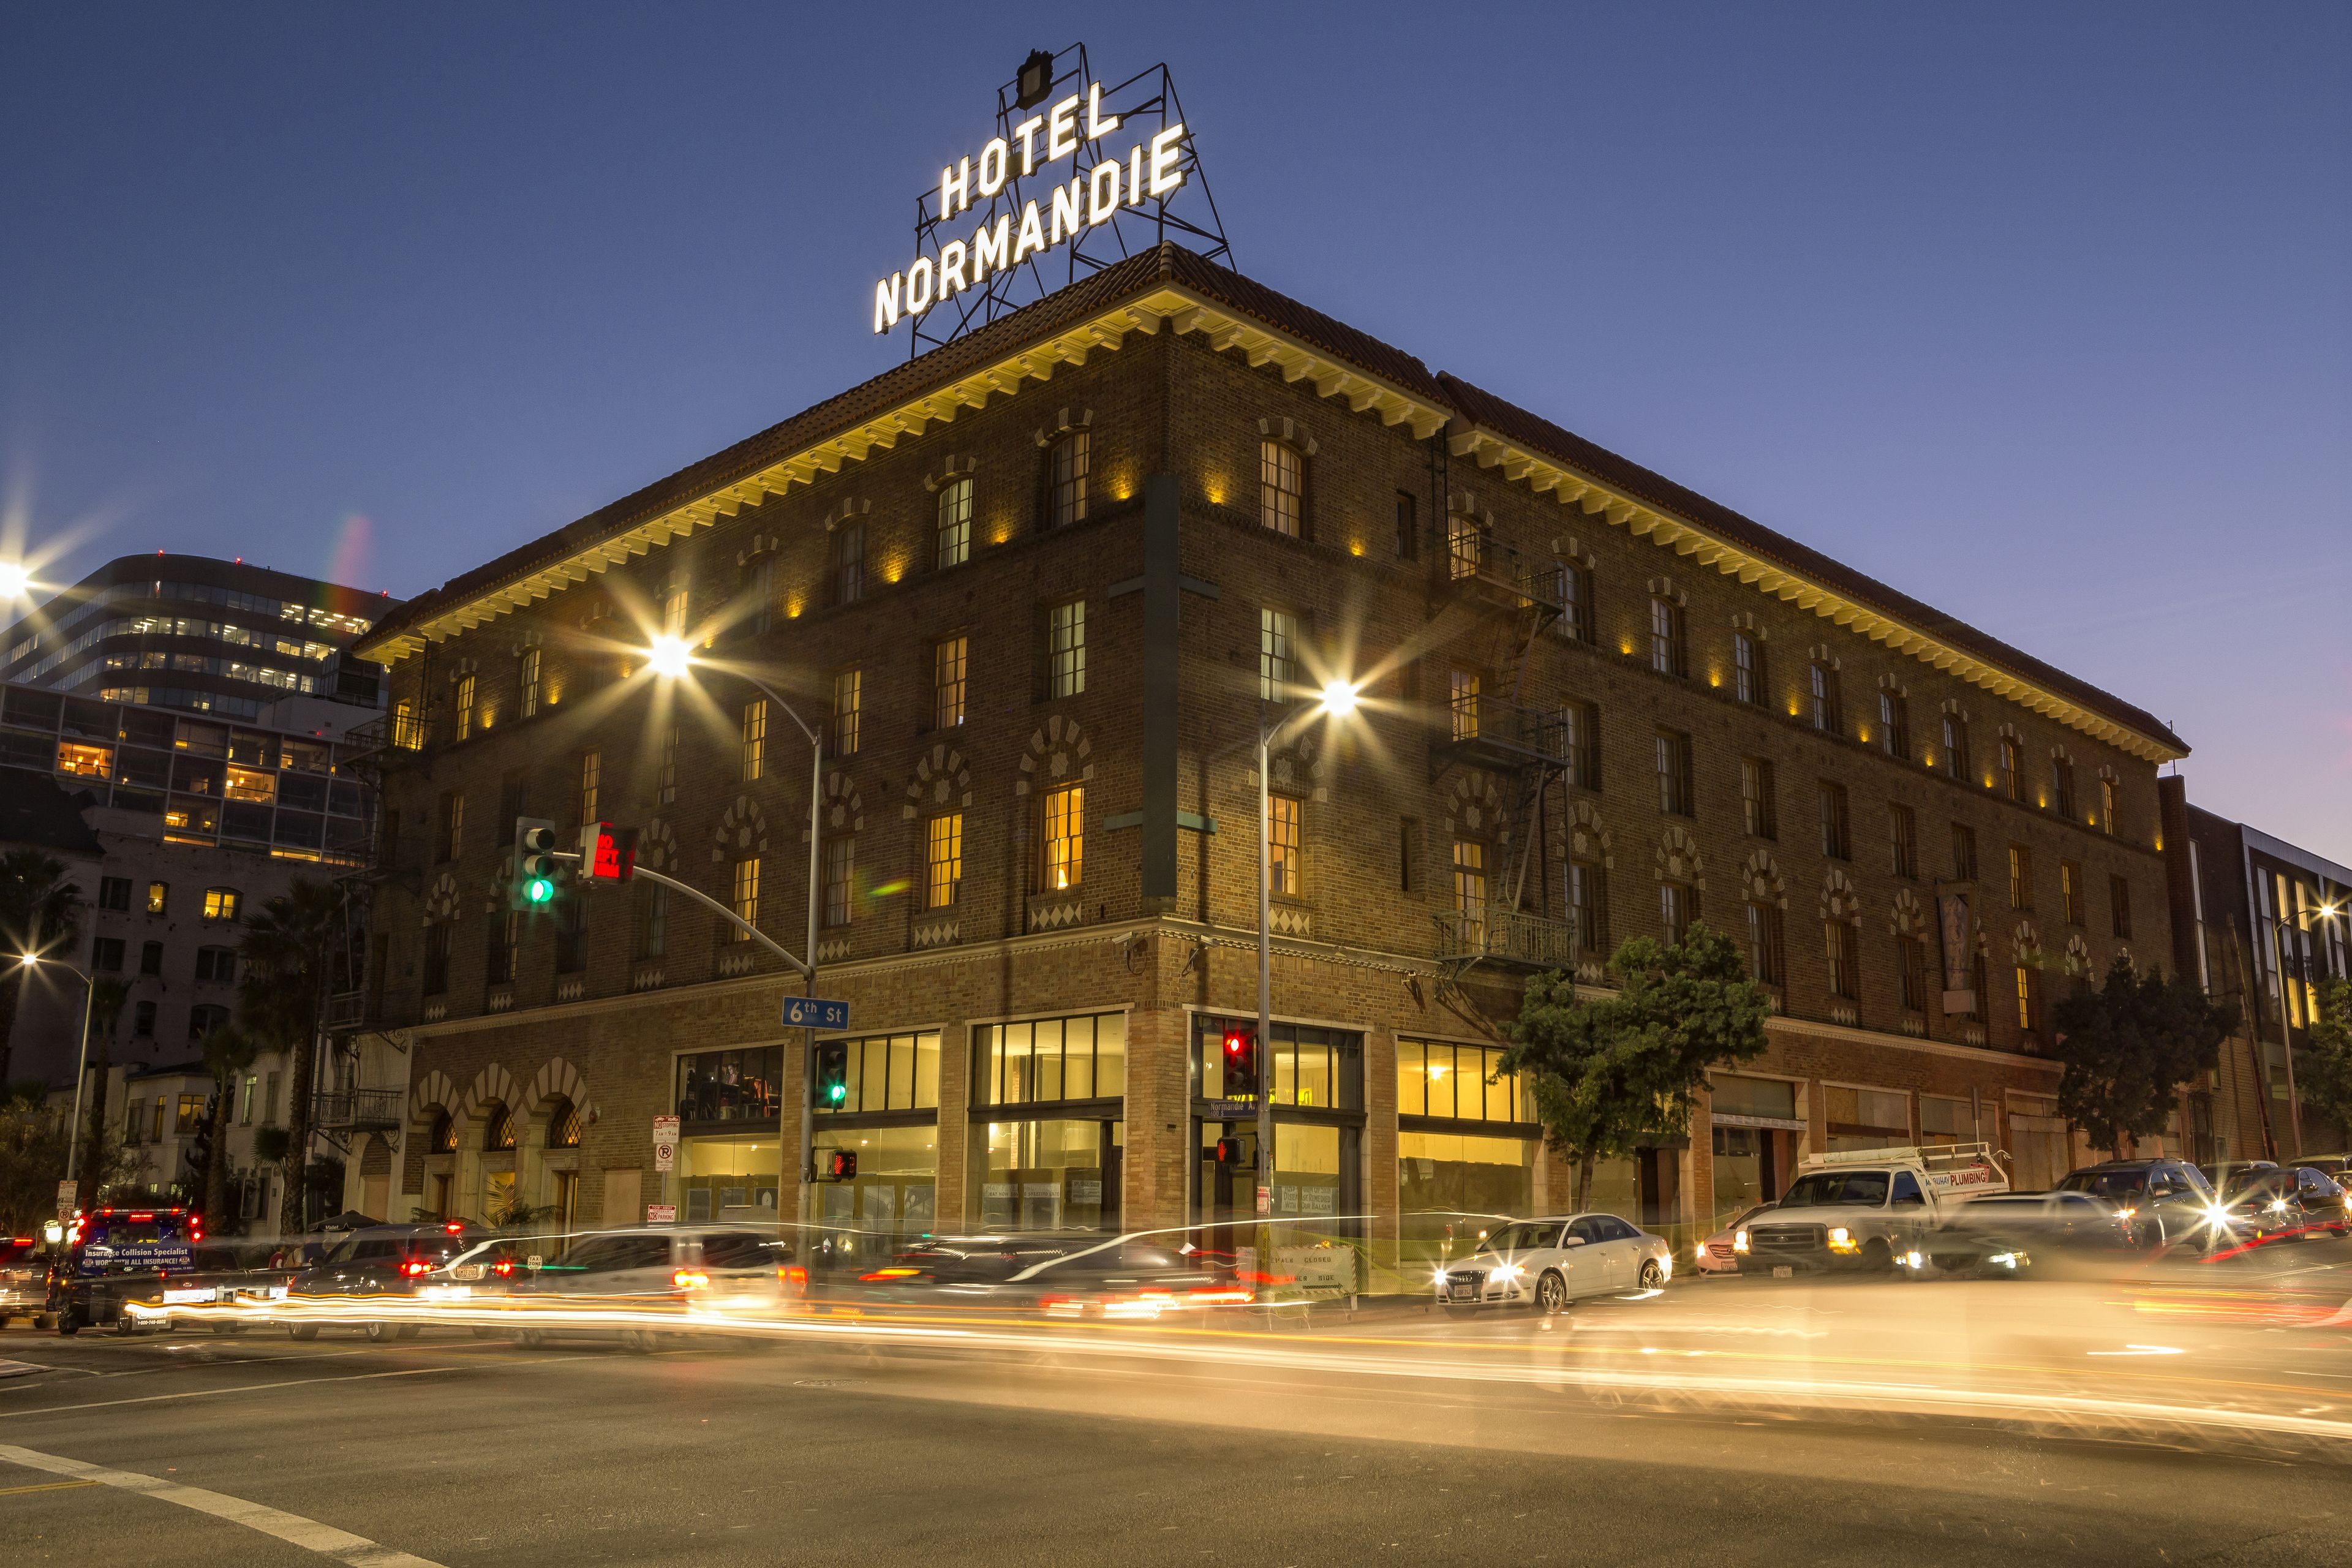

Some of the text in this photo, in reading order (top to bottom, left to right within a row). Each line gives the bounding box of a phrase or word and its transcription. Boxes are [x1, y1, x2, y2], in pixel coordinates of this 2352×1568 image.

[941, 80, 1118, 221] HOTEL
[874, 123, 1183, 335] NORMANDIE
[595, 849, 619, 864] EFT
[594, 862, 620, 878] URN
[790, 1001, 842, 1023] 6th St
[1210, 1102, 1244, 1111] Normandie
[1925, 1172, 1985, 1186] MBUHAY PLUMBING
[154, 1248, 187, 1256] Specialist
